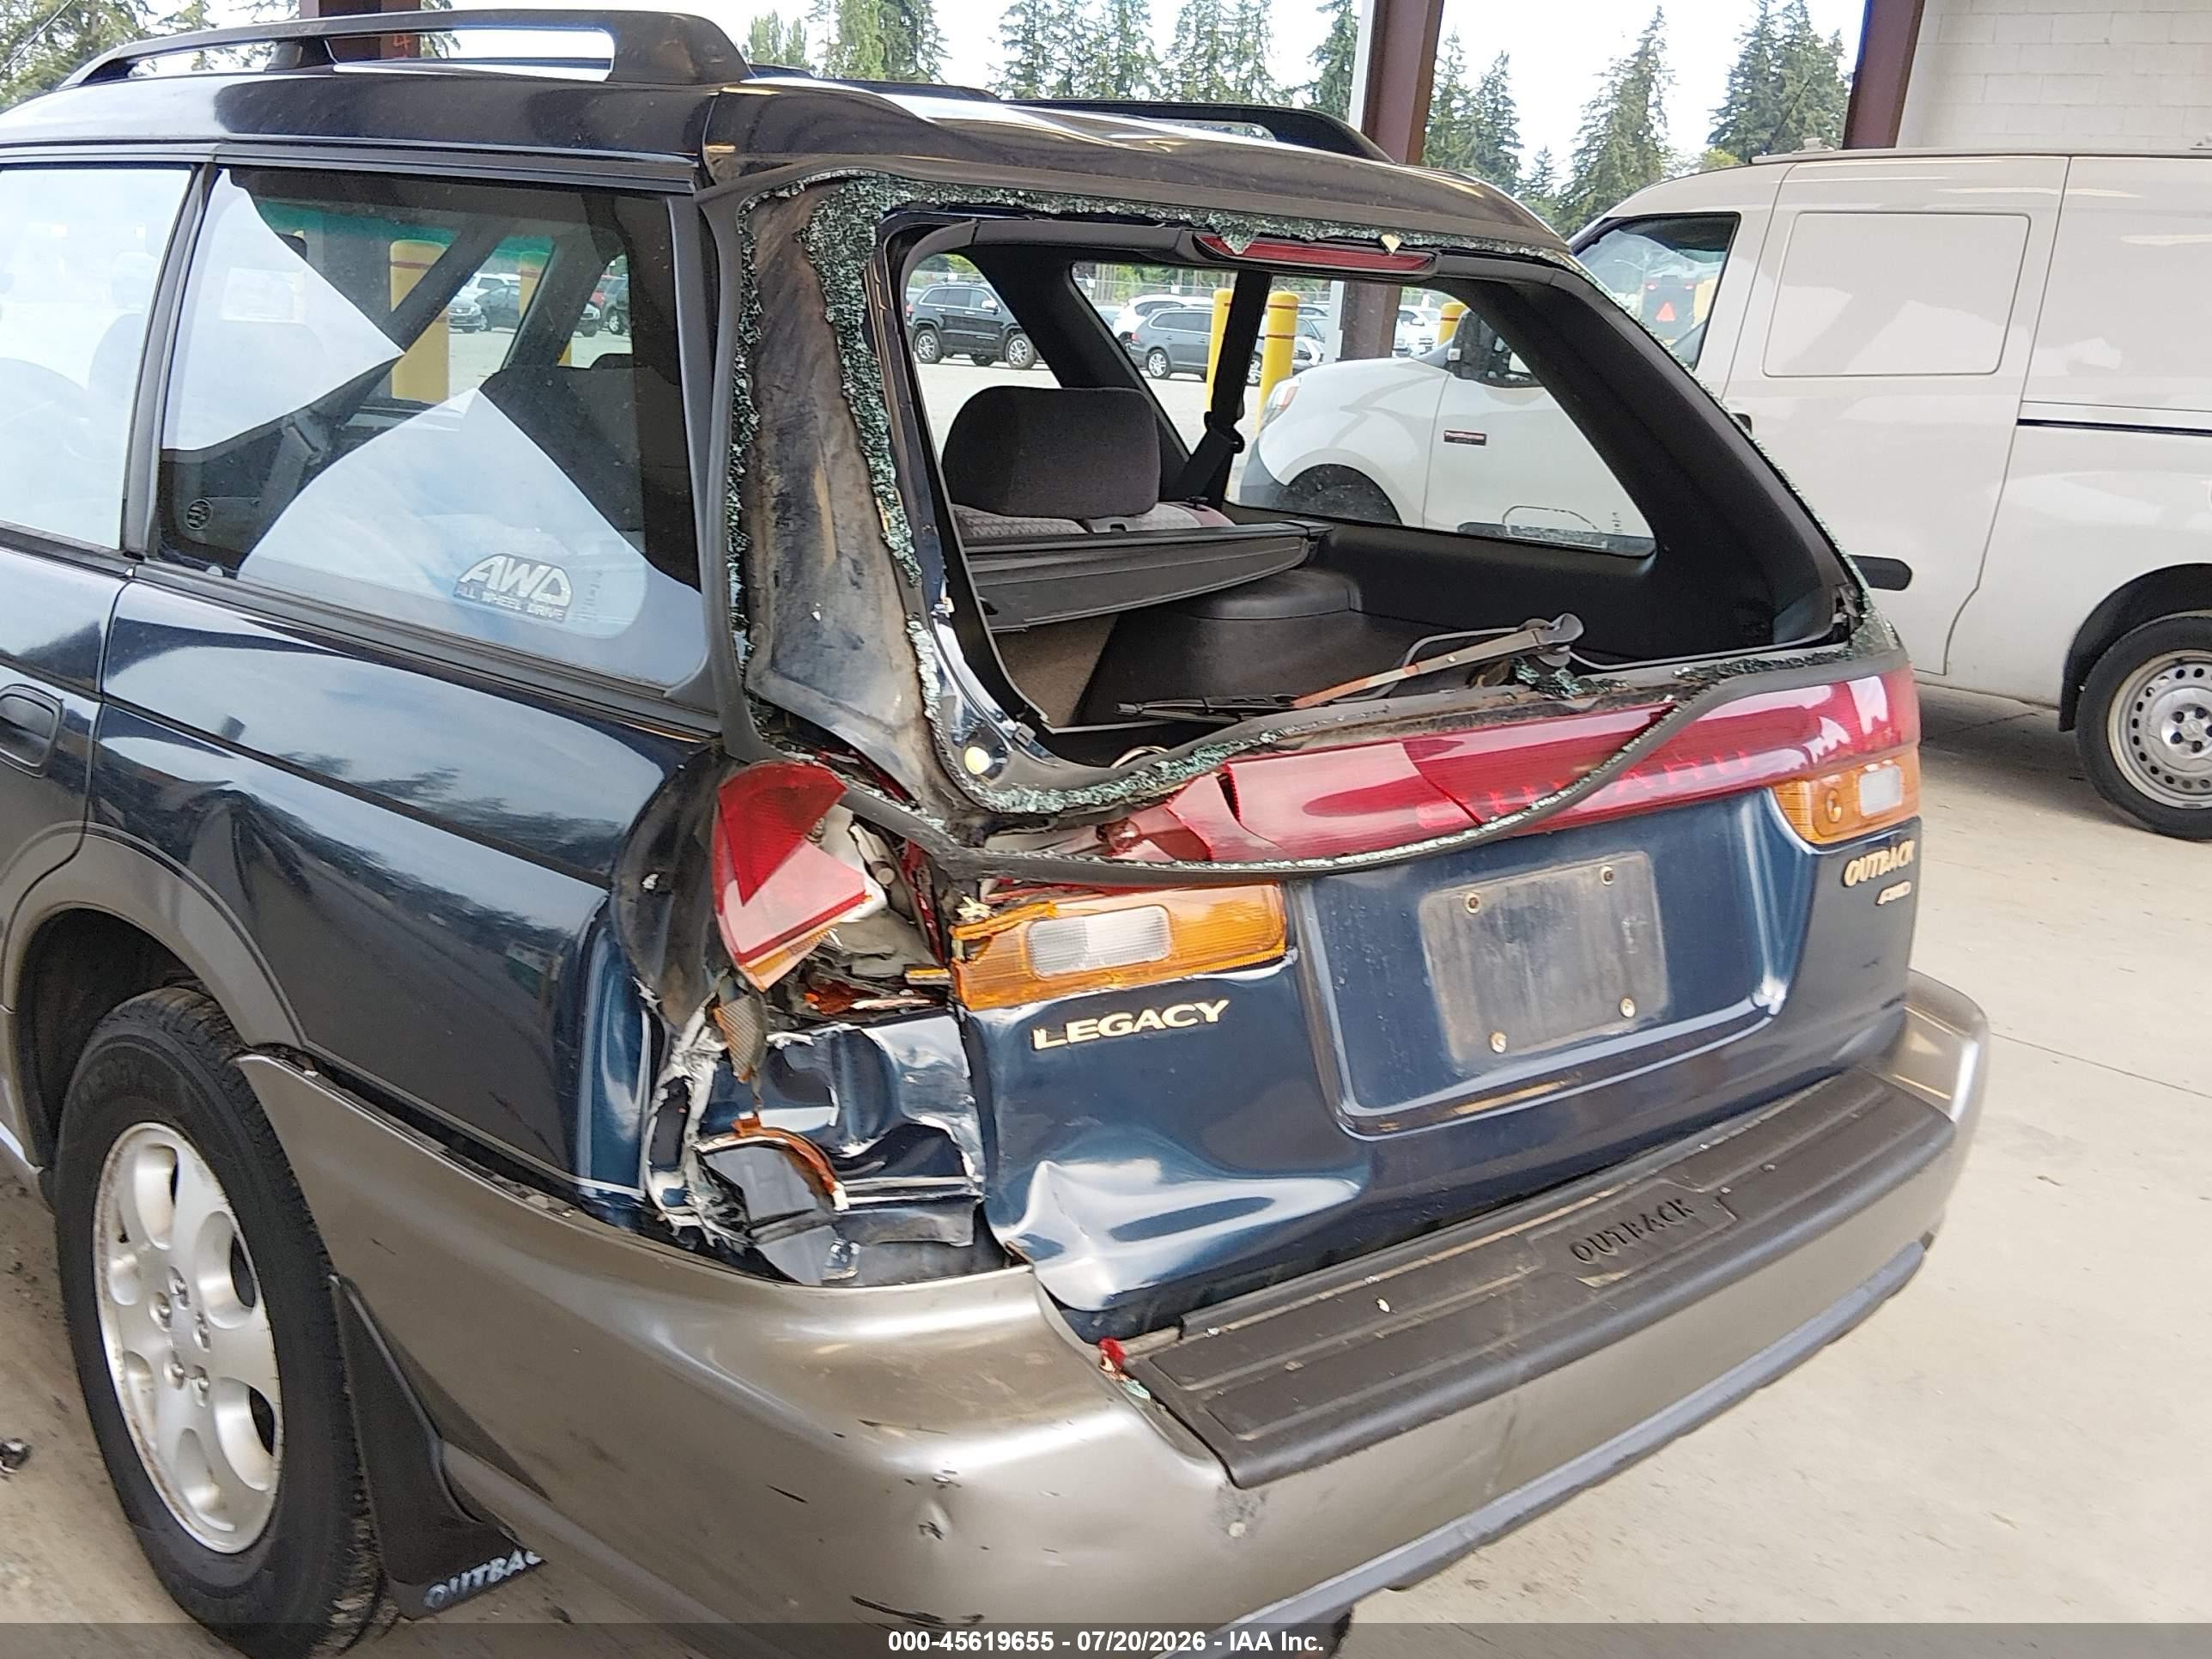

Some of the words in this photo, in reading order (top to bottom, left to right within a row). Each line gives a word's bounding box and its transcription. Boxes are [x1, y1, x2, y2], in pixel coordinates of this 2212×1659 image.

[454, 585, 478, 599] ALL
[481, 590, 523, 611] WHEEL
[526, 602, 566, 620] DRIVE
[459, 555, 572, 608] AWD
[1415, 747, 1753, 830] SUARU
[1843, 838, 1915, 887] OUTBACK
[1032, 999, 1231, 1051] LEGACY
[1570, 1198, 1695, 1264] OUTBACK
